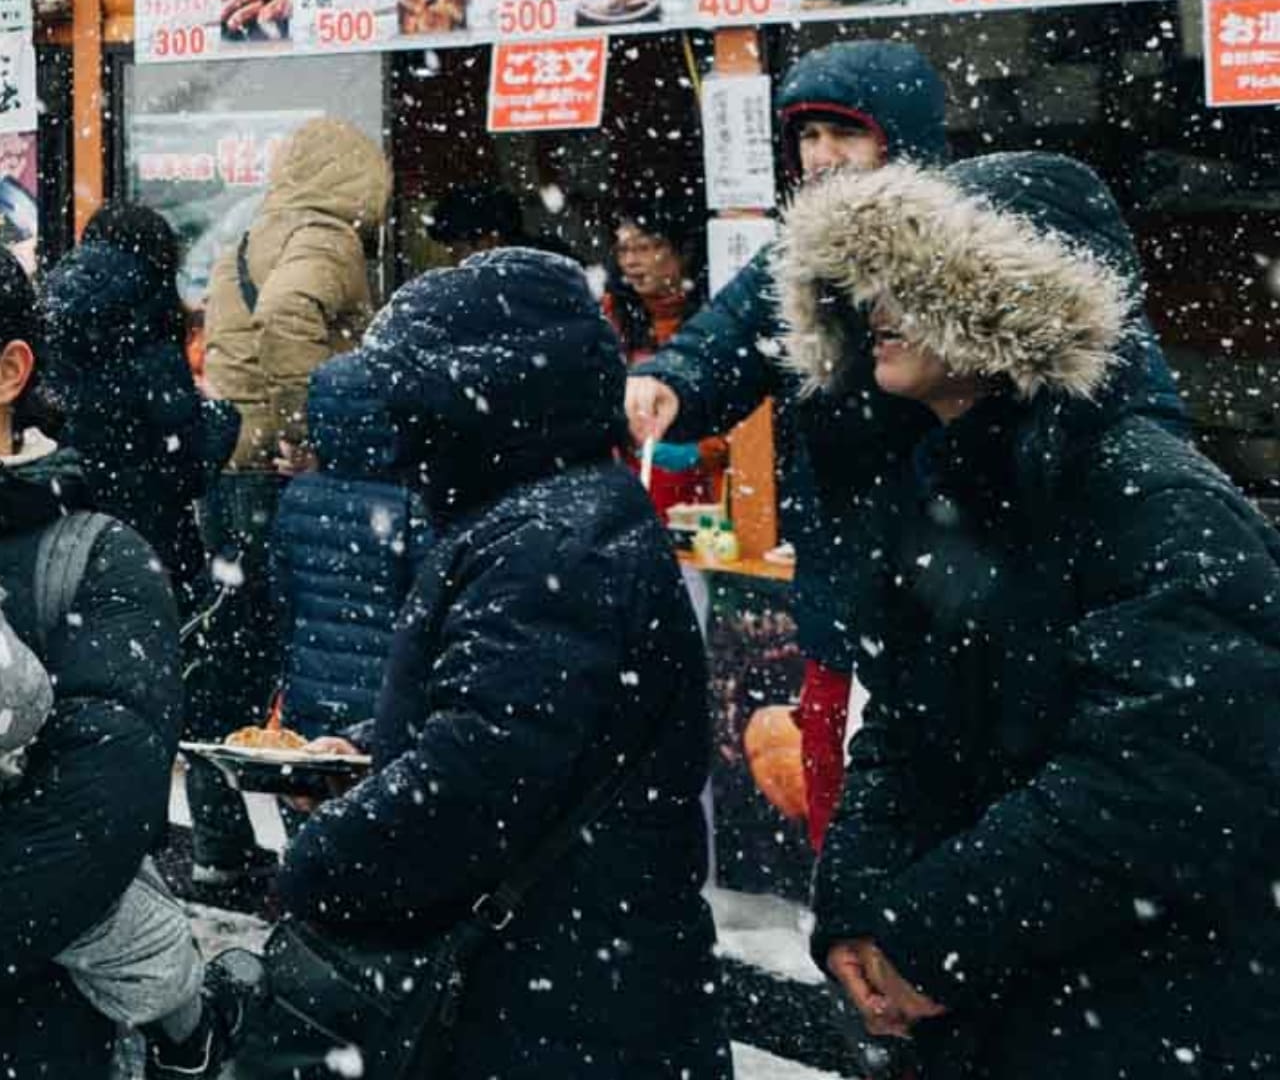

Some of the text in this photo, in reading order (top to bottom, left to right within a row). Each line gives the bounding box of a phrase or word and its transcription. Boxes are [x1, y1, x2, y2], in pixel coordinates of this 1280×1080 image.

[154, 24, 206, 56] 300
[318, 10, 373, 43] 500
[501, 49, 597, 84] ご注文
